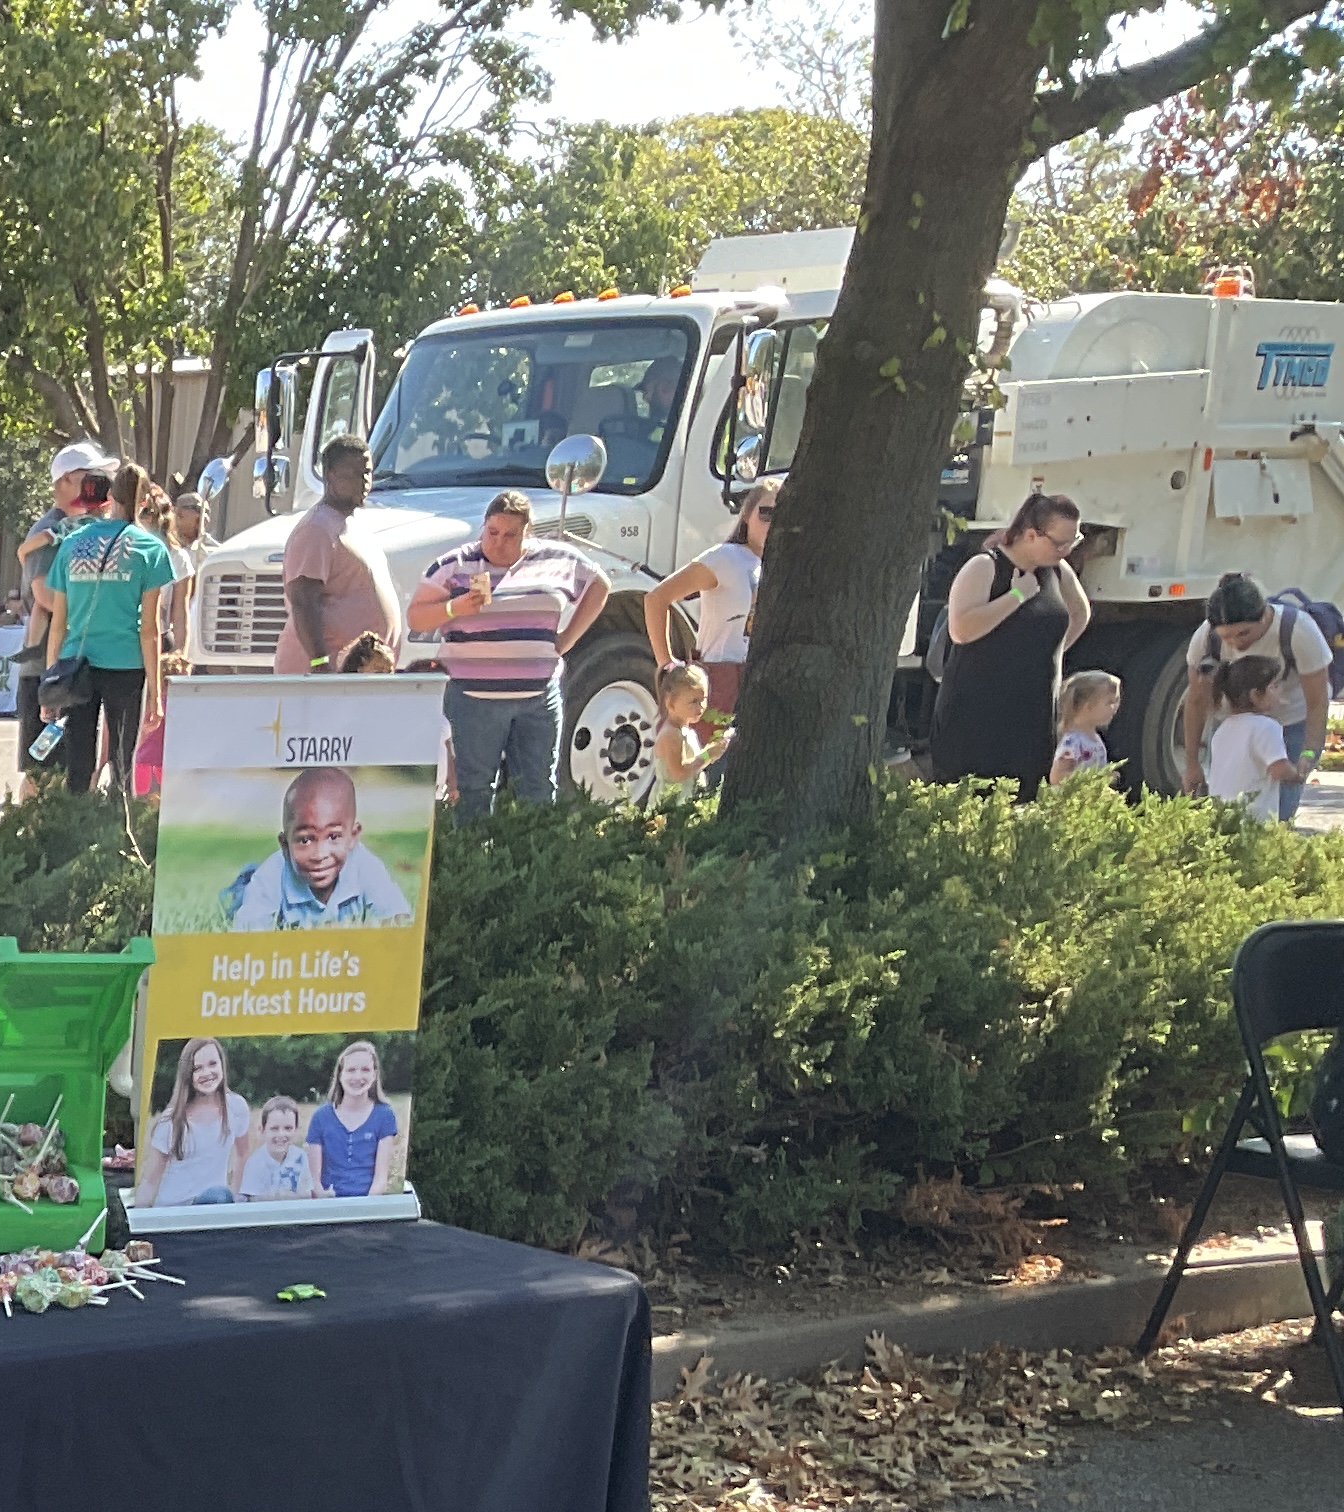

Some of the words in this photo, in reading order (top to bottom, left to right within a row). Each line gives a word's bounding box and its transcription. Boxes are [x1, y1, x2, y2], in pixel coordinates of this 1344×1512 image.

[620, 525, 639, 538] 958
[285, 735, 353, 763] STARRY
[211, 952, 265, 987] Help
[271, 950, 293, 979] in
[299, 949, 360, 978] Life's
[201, 988, 292, 1018] Darkest
[297, 987, 367, 1014] Hours
